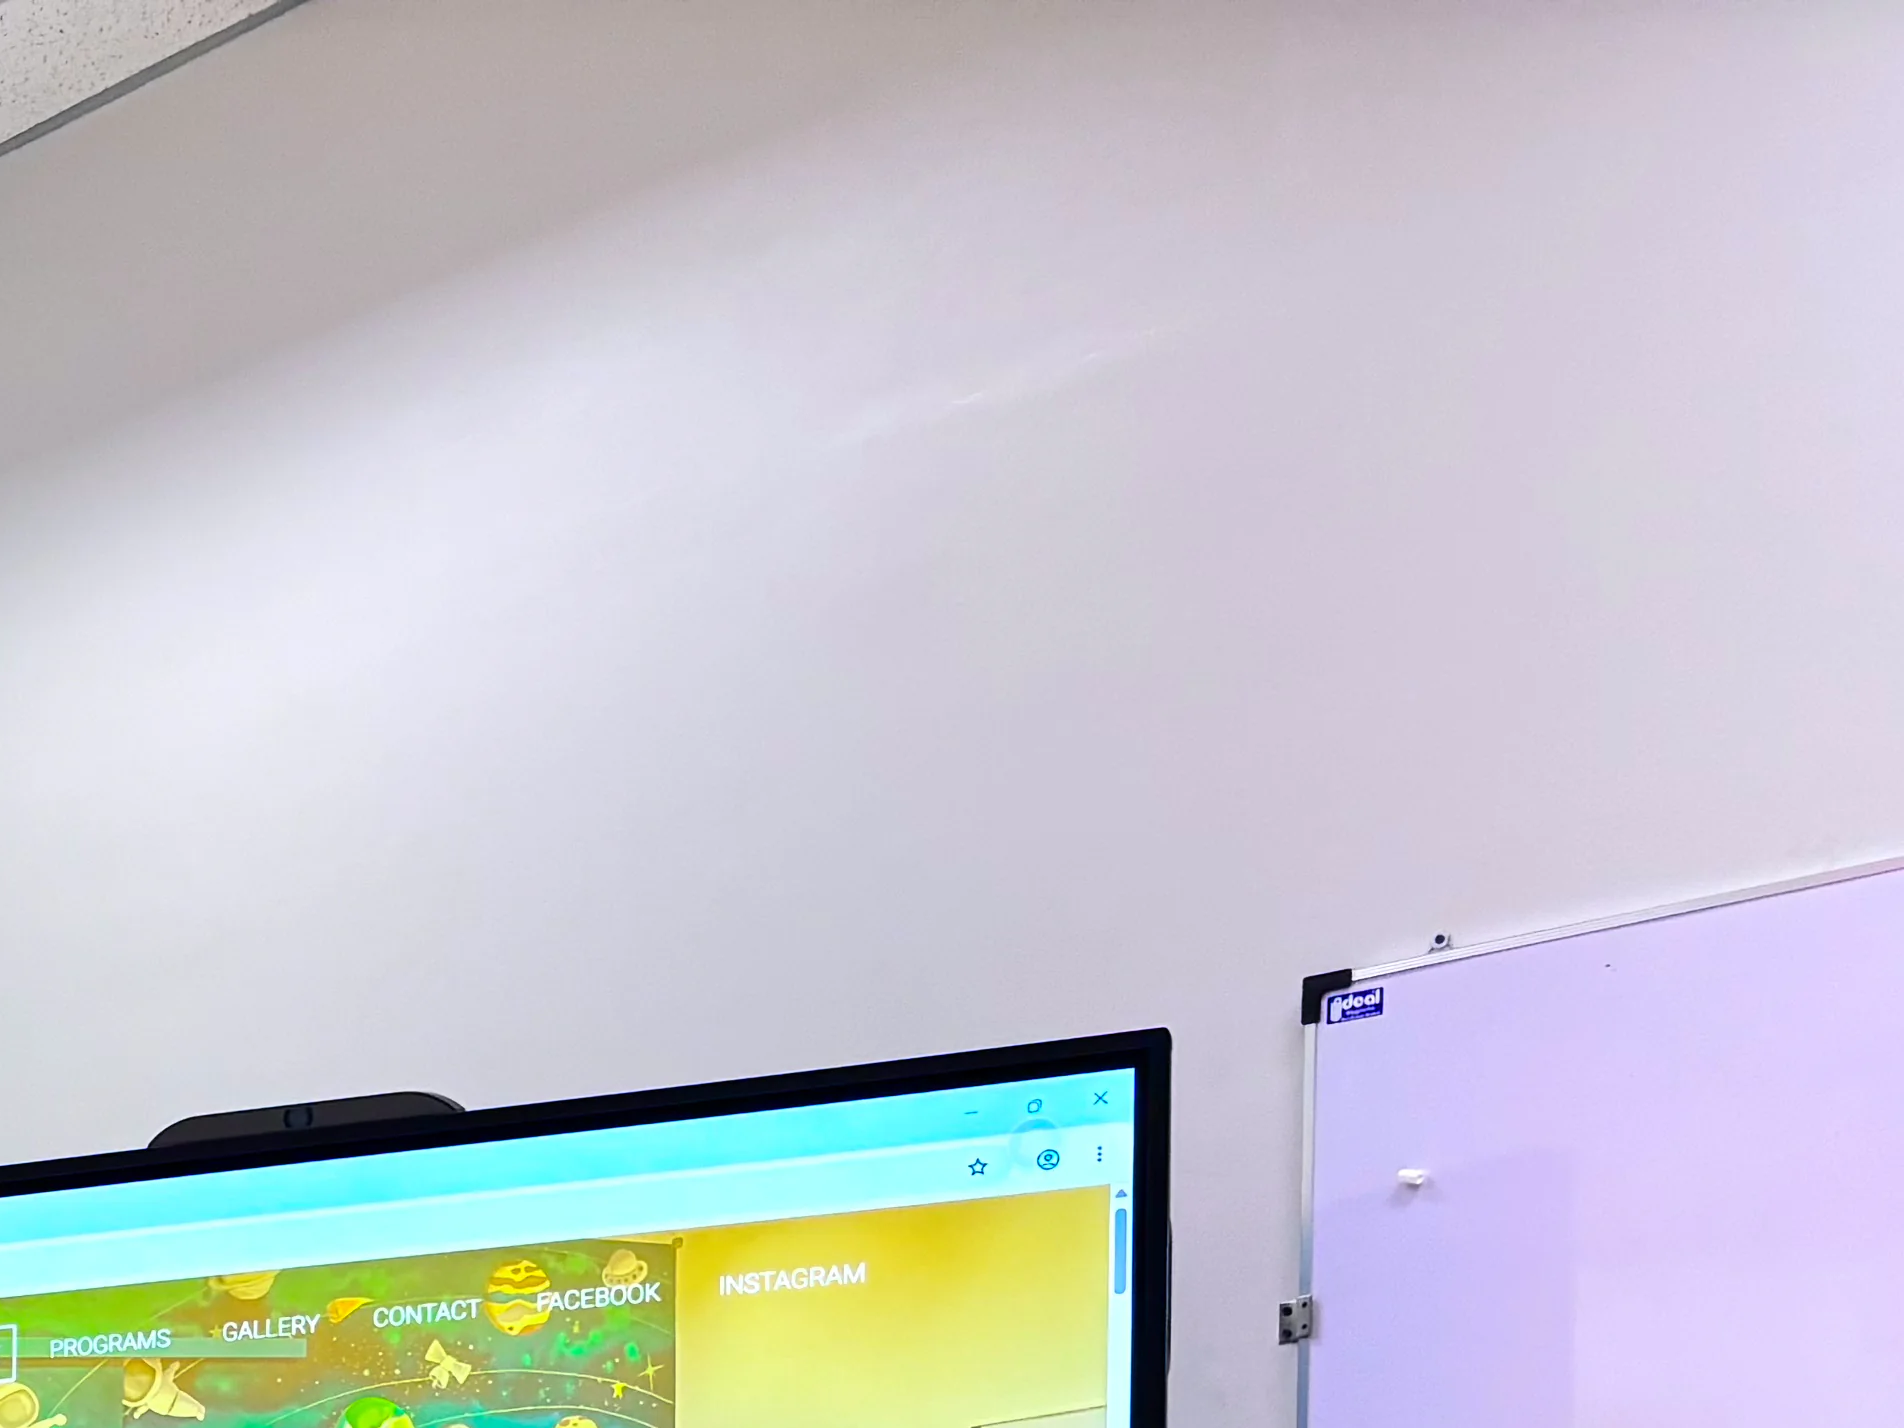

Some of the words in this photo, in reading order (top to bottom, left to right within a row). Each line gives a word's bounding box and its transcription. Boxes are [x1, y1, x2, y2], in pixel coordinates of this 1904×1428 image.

[49, 1328, 172, 1359] PROGRAMS
[221, 1313, 321, 1343] GALLERY
[373, 1297, 483, 1328] CONTACT
[536, 1281, 662, 1313] FACEBOOK
[718, 1262, 867, 1297] INSTAGRAM
